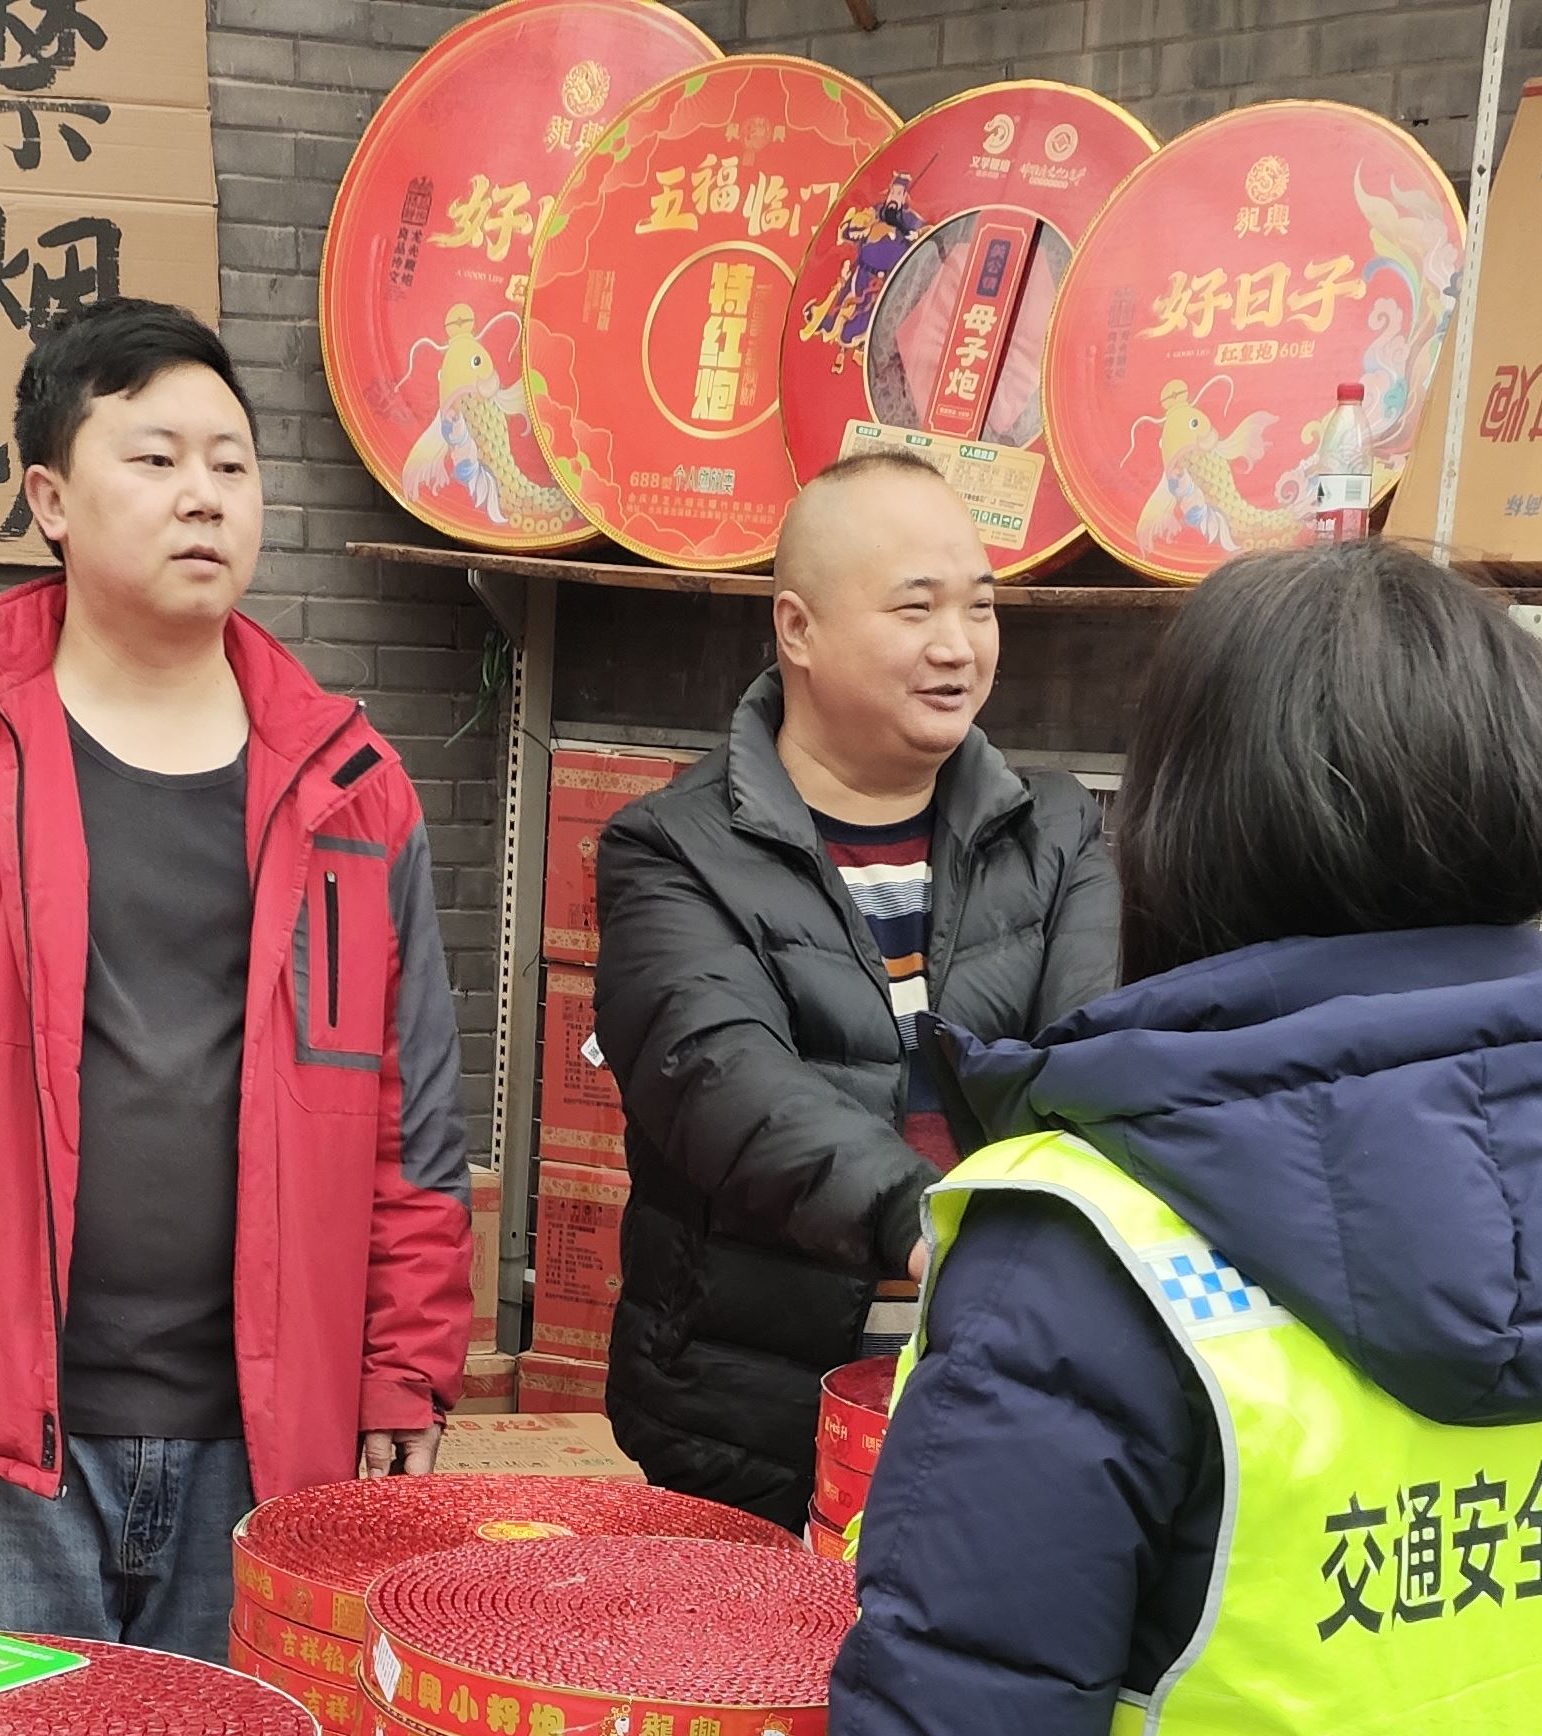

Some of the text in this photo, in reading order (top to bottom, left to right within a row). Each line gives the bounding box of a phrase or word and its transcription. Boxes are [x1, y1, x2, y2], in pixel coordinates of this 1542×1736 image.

[426, 173, 556, 262] 好
[635, 154, 841, 239] 五福临门
[1135, 254, 1366, 339] 好日子
[691, 262, 755, 421] 特红炮
[945, 303, 997, 401] 母子炮
